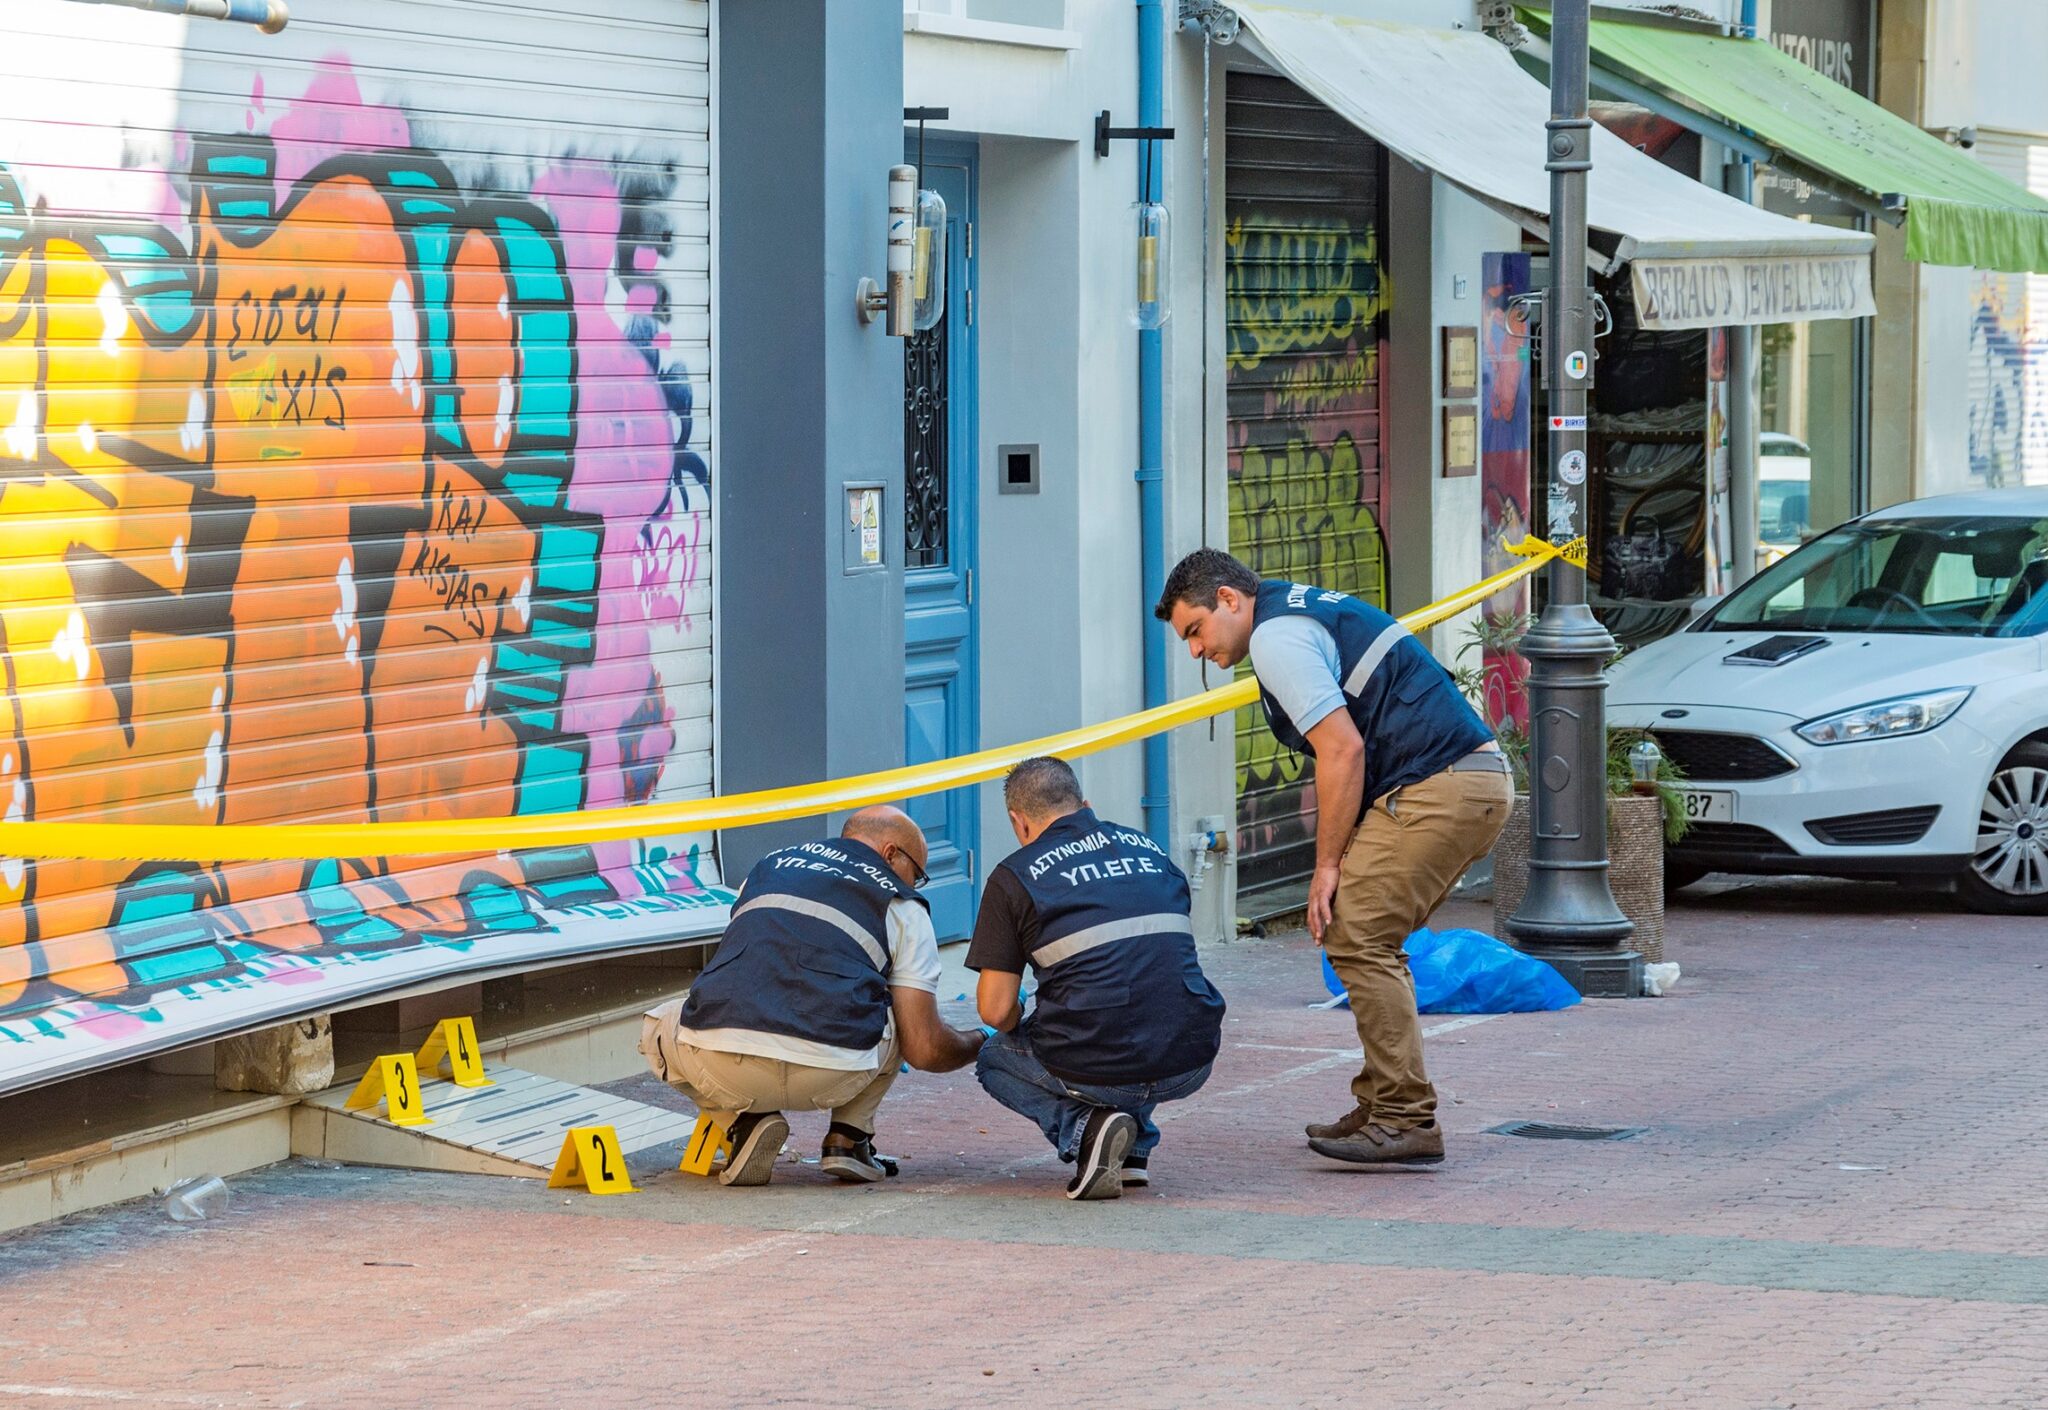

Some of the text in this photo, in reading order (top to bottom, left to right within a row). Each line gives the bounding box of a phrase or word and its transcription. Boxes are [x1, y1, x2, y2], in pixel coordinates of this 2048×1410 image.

[1642, 259, 1857, 321] BERAUD JEWELLERY
[1676, 793, 1713, 818] 87
[764, 842, 849, 863] ΝΟΜΙΑ
[1028, 831, 1111, 881] ΑΣΤΥΝΟΜΙΑ
[458, 1023, 471, 1070] 4
[395, 1061, 408, 1111] 3
[592, 1134, 614, 1182] 2
[694, 1119, 714, 1164] 1
